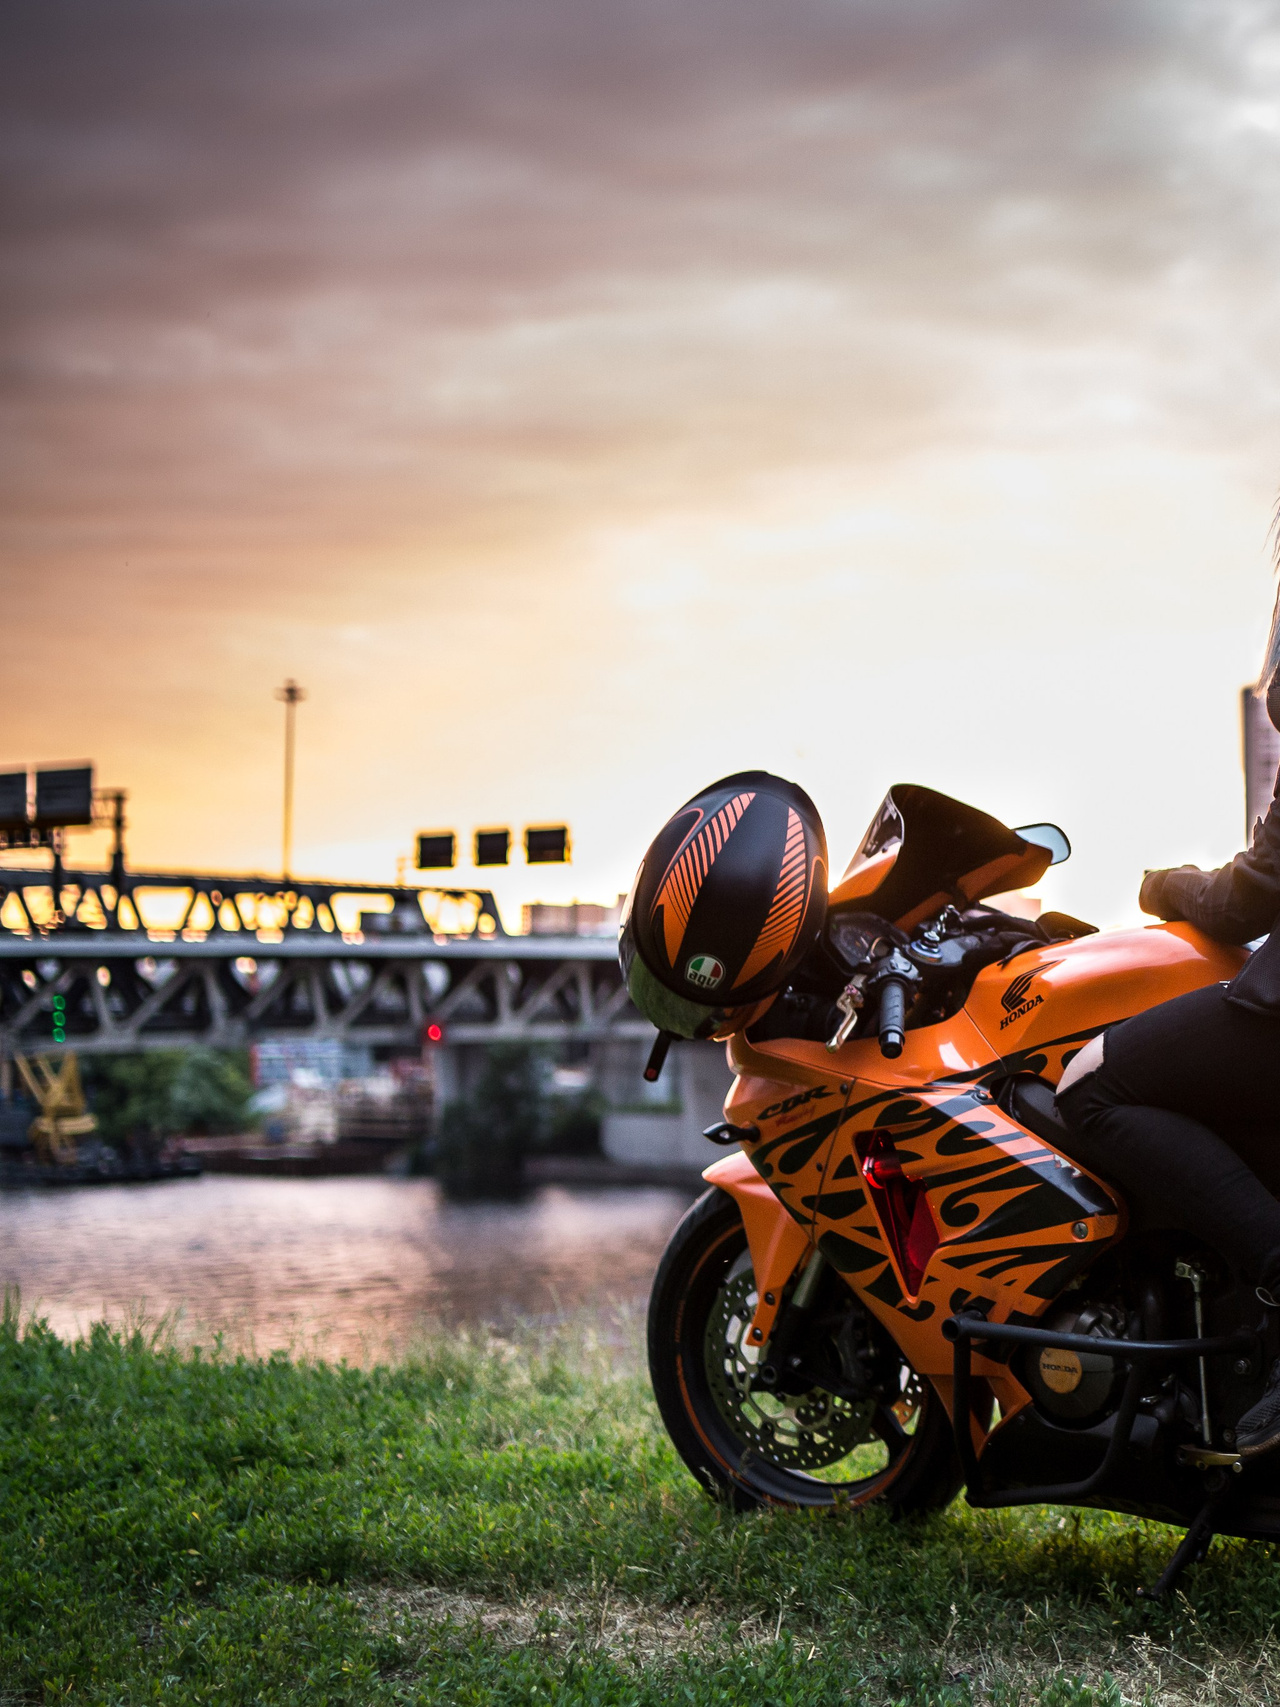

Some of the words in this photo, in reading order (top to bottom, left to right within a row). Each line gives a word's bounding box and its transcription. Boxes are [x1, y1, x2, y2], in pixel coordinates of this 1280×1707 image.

[1000, 994, 1044, 1030] HONDA
[757, 1085, 836, 1120] CBR
[1042, 1363, 1078, 1374] HONDA
